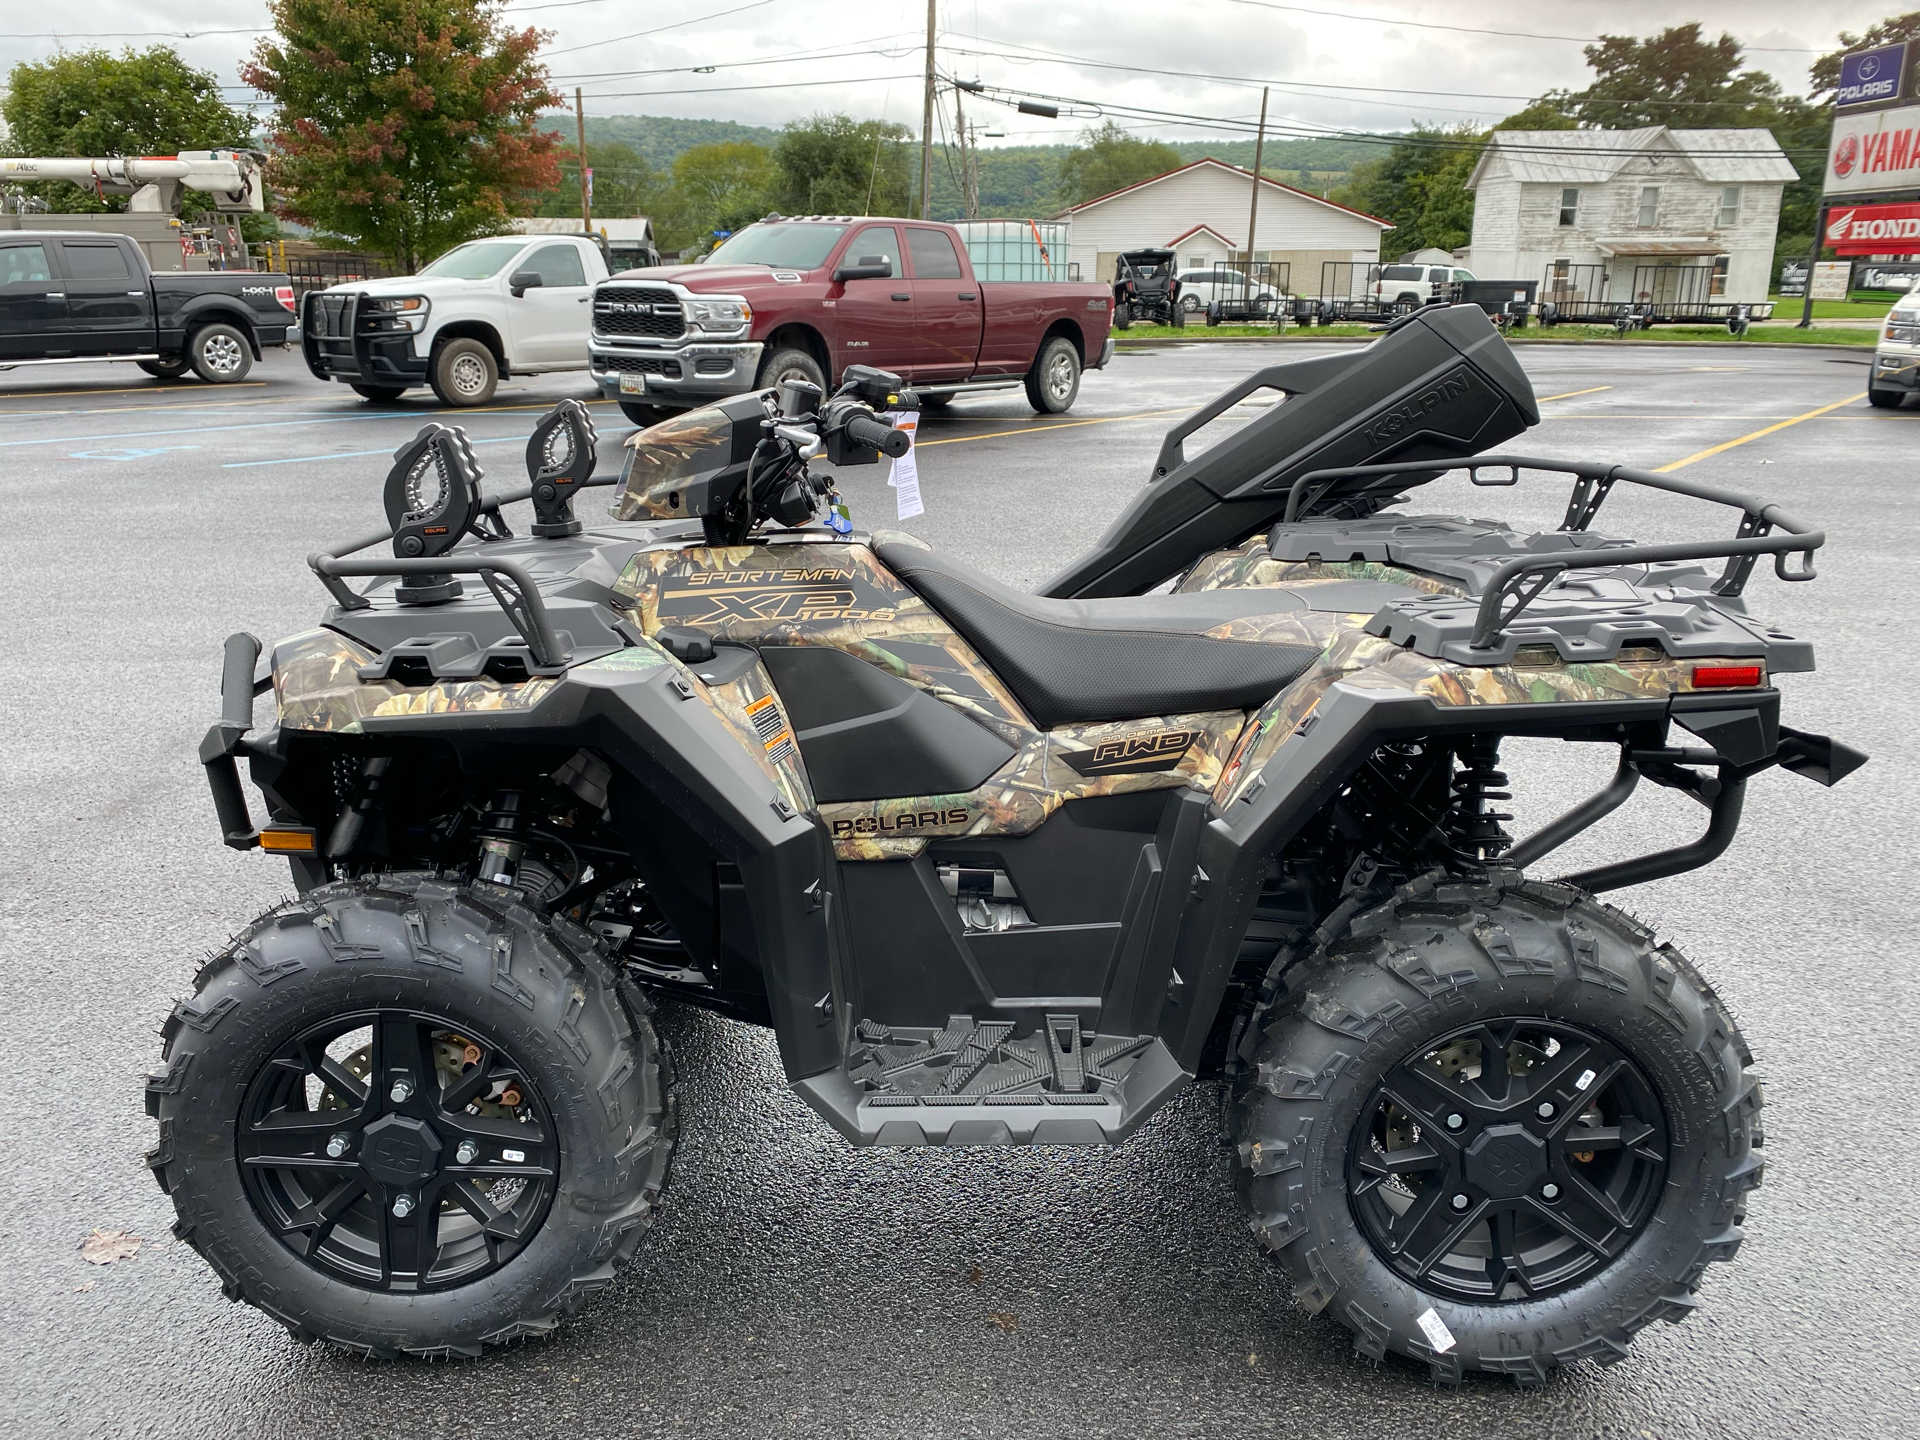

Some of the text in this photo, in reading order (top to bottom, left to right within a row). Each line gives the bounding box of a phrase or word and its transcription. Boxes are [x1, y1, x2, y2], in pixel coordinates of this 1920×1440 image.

[1839, 79, 1895, 100] POLARIS
[612, 303, 651, 313] RAM
[1364, 373, 1470, 448] KOLPIN
[687, 568, 857, 586] SPORTSMAN
[685, 589, 858, 626] XP
[800, 609, 897, 622] 1000
[1093, 730, 1192, 762] AWD
[1100, 724, 1187, 743] ON DEMAND
[832, 808, 969, 836] POLARIS
[1344, 989, 1467, 1080] POLARIS
[193, 1193, 283, 1299] POLARIS
